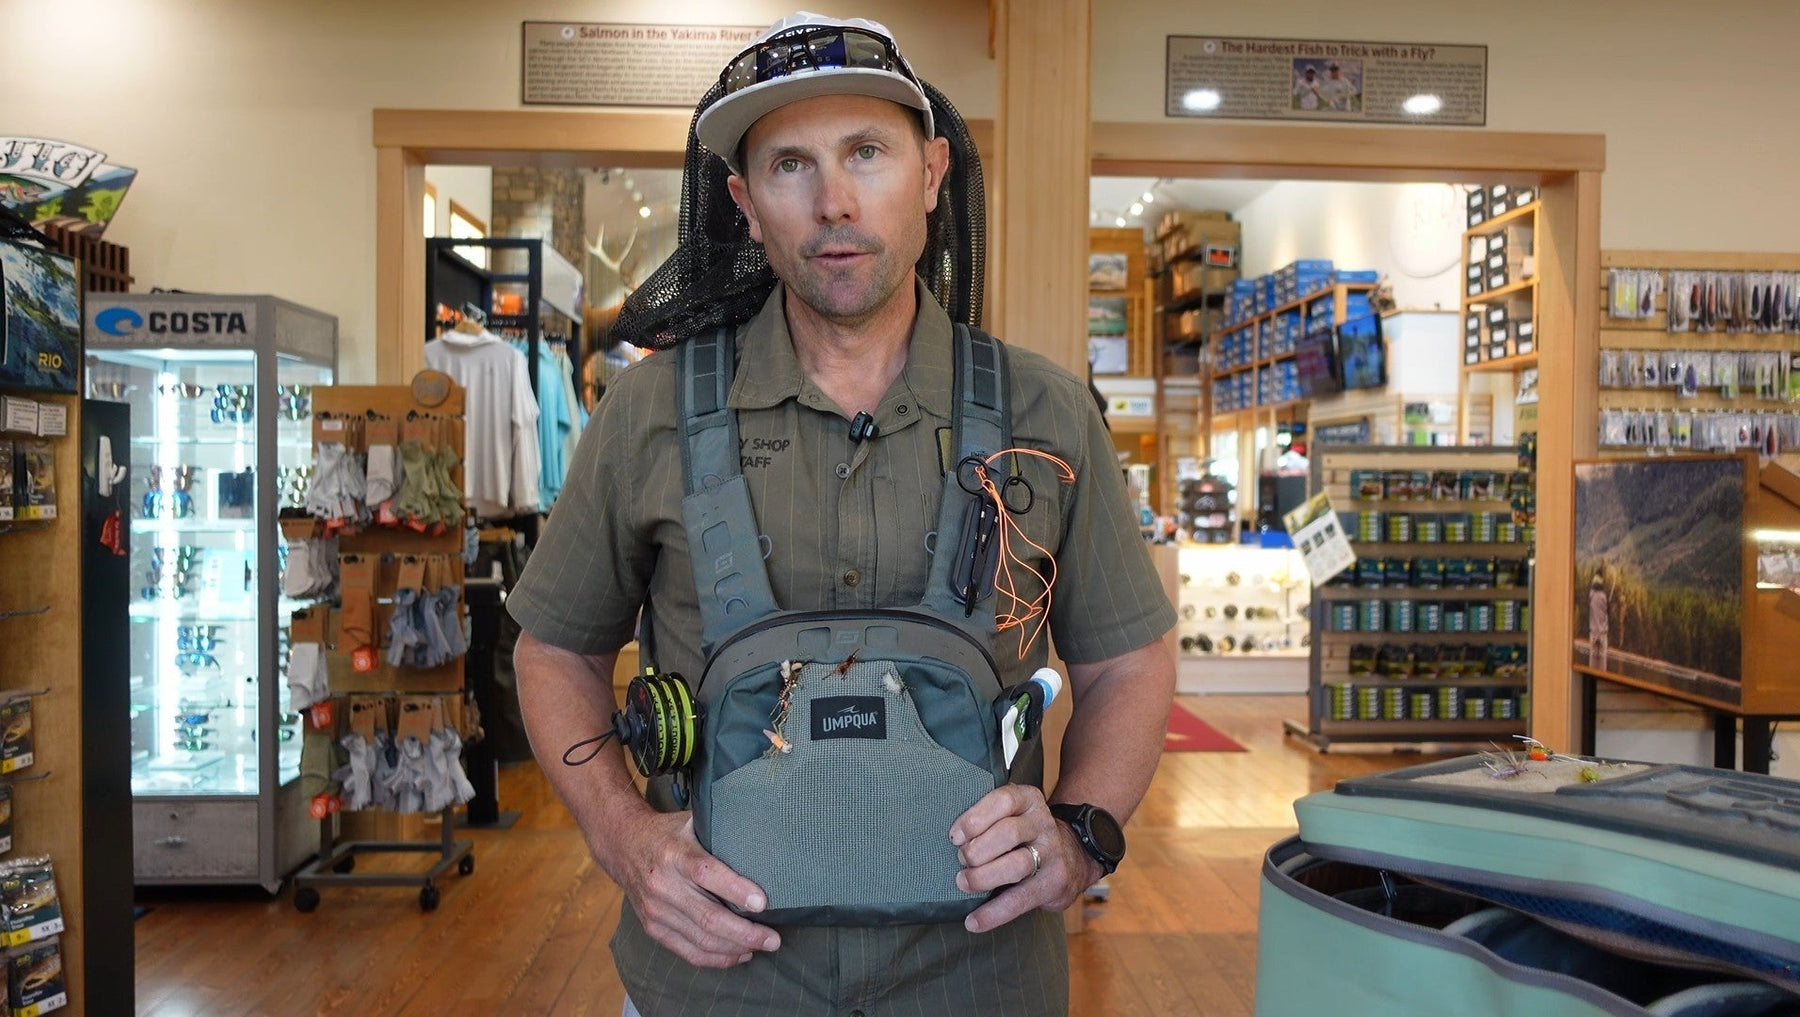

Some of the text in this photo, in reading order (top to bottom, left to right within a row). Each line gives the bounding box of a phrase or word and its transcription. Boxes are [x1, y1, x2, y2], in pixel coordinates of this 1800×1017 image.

[579, 26, 629, 39] Salmon
[632, 27, 644, 39] in
[647, 28, 667, 40] the
[671, 28, 718, 40] Yakima
[720, 29, 752, 41] River
[1221, 41, 1436, 61] The Hardest Fish to Trick with a Fly?
[149, 312, 247, 334] COSTA
[38, 352, 63, 369] RIO
[752, 438, 790, 452] SHOP
[740, 455, 772, 469] TAFF
[822, 711, 878, 733] UMPQUA
